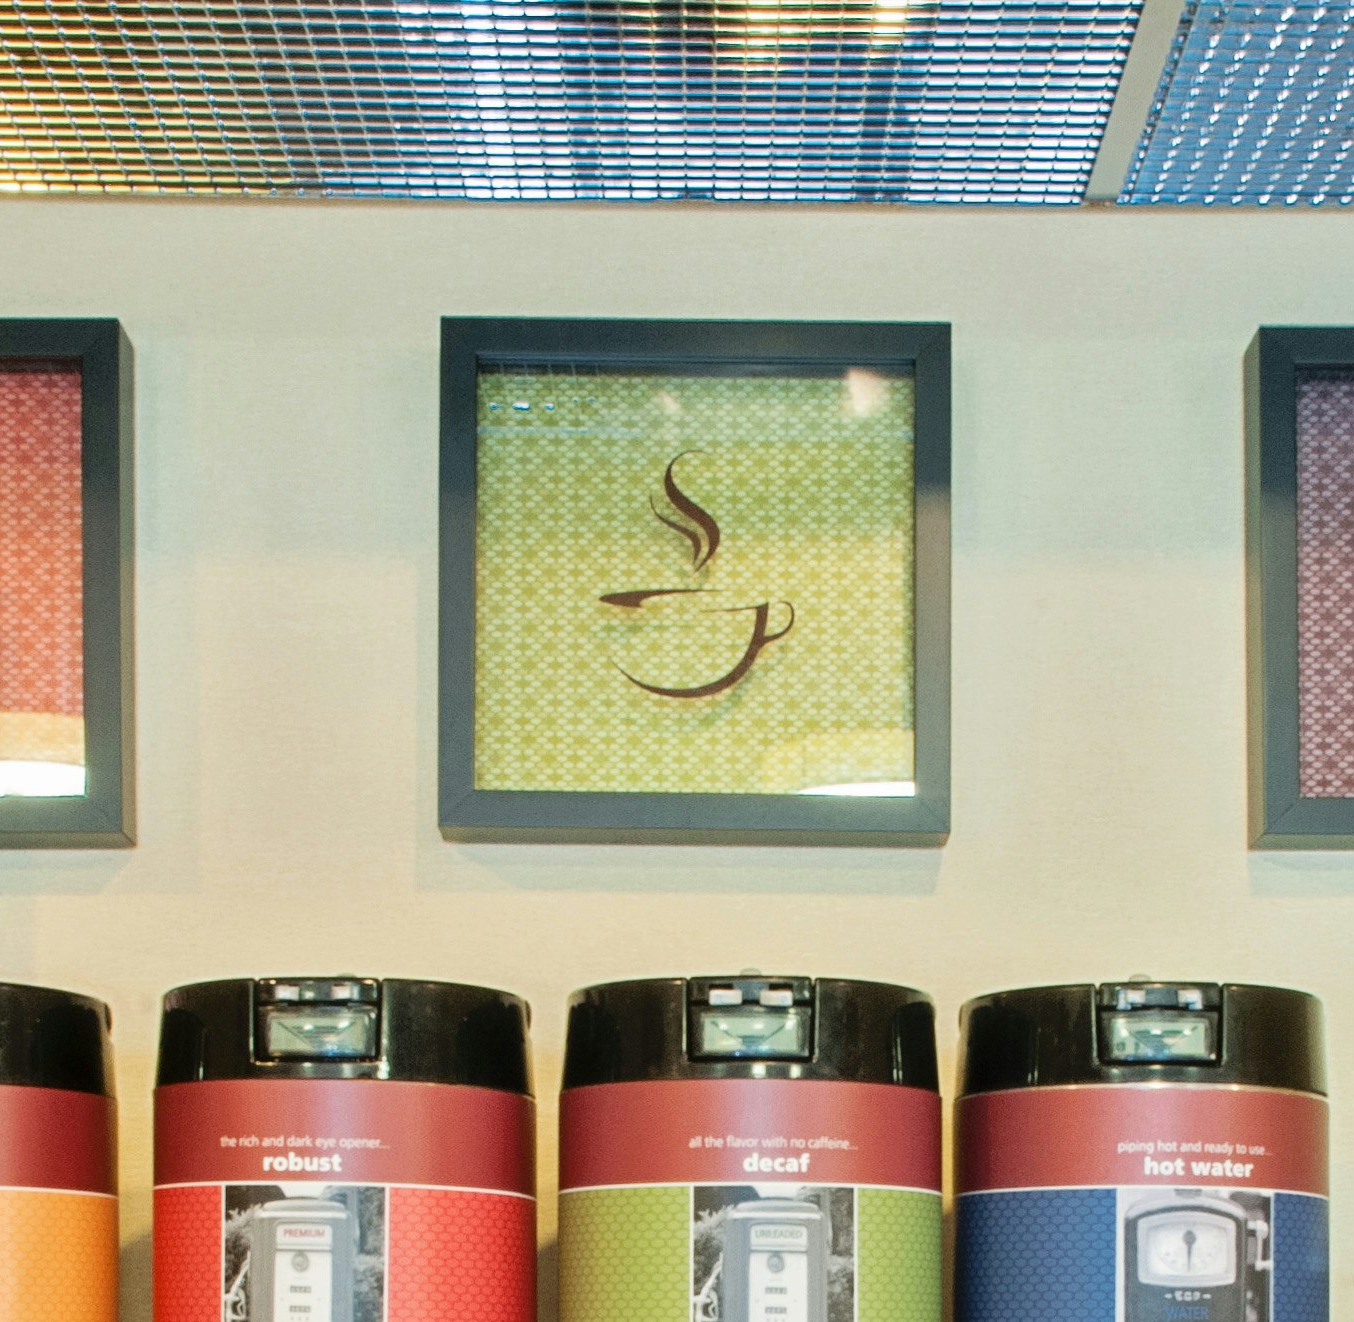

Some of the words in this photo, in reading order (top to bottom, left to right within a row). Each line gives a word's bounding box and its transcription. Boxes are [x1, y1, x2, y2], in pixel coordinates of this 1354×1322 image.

[220, 1136, 237, 1148] the
[239, 1135, 260, 1148] rich
[261, 1135, 285, 1148] and
[286, 1134, 313, 1148] dark
[315, 1137, 337, 1150] eye
[688, 1136, 703, 1149] all
[704, 1136, 724, 1149] the
[726, 1134, 759, 1148] flavor
[761, 1135, 788, 1148] with
[789, 1138, 806, 1149] no
[1117, 1140, 1155, 1155] piping
[1157, 1139, 1178, 1152] hot
[1180, 1141, 1203, 1153] and
[1204, 1141, 1235, 1156] ready
[1236, 1143, 1248, 1155] to
[262, 1152, 342, 1172] robust
[743, 1152, 811, 1173] decaf
[1144, 1156, 1186, 1176] hot
[1190, 1159, 1255, 1178] water
[282, 1228, 326, 1239] PREMIUM
